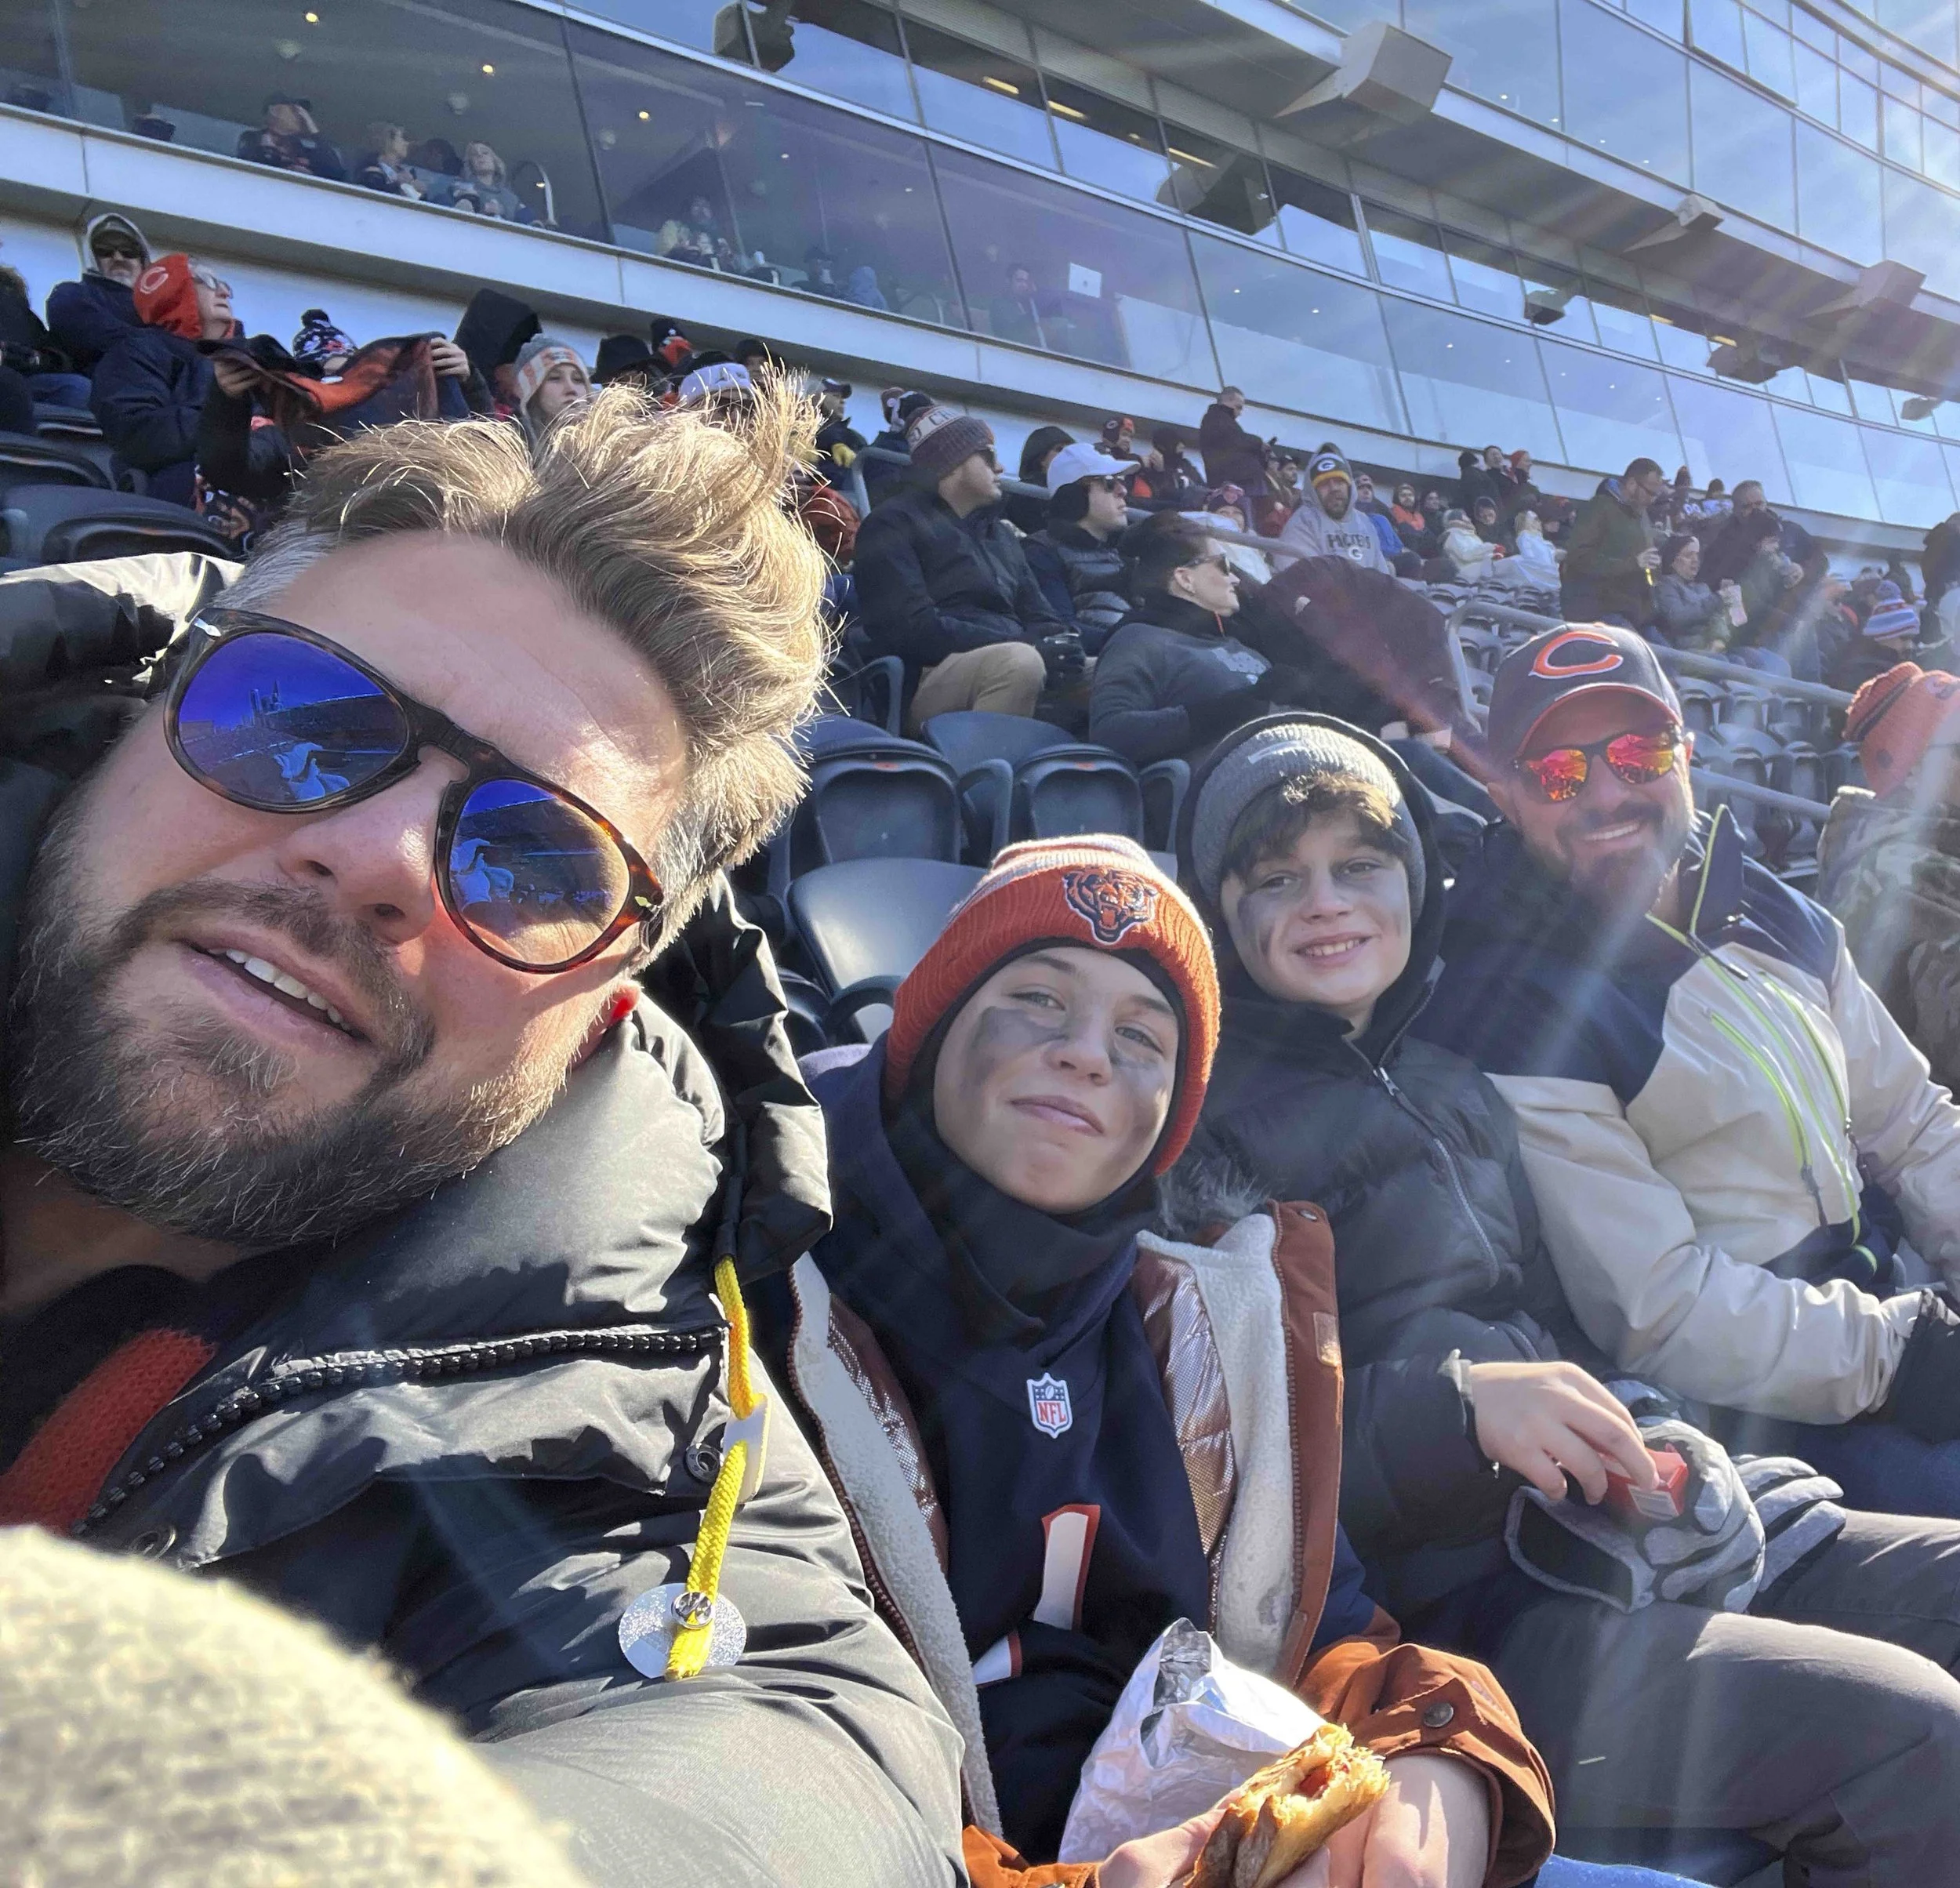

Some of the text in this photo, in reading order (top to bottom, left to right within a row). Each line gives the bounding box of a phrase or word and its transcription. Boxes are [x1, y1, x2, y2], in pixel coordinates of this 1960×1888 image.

[140, 267, 169, 294] C
[1528, 631, 1624, 680] C
[1037, 1402, 1067, 1425] NFL
